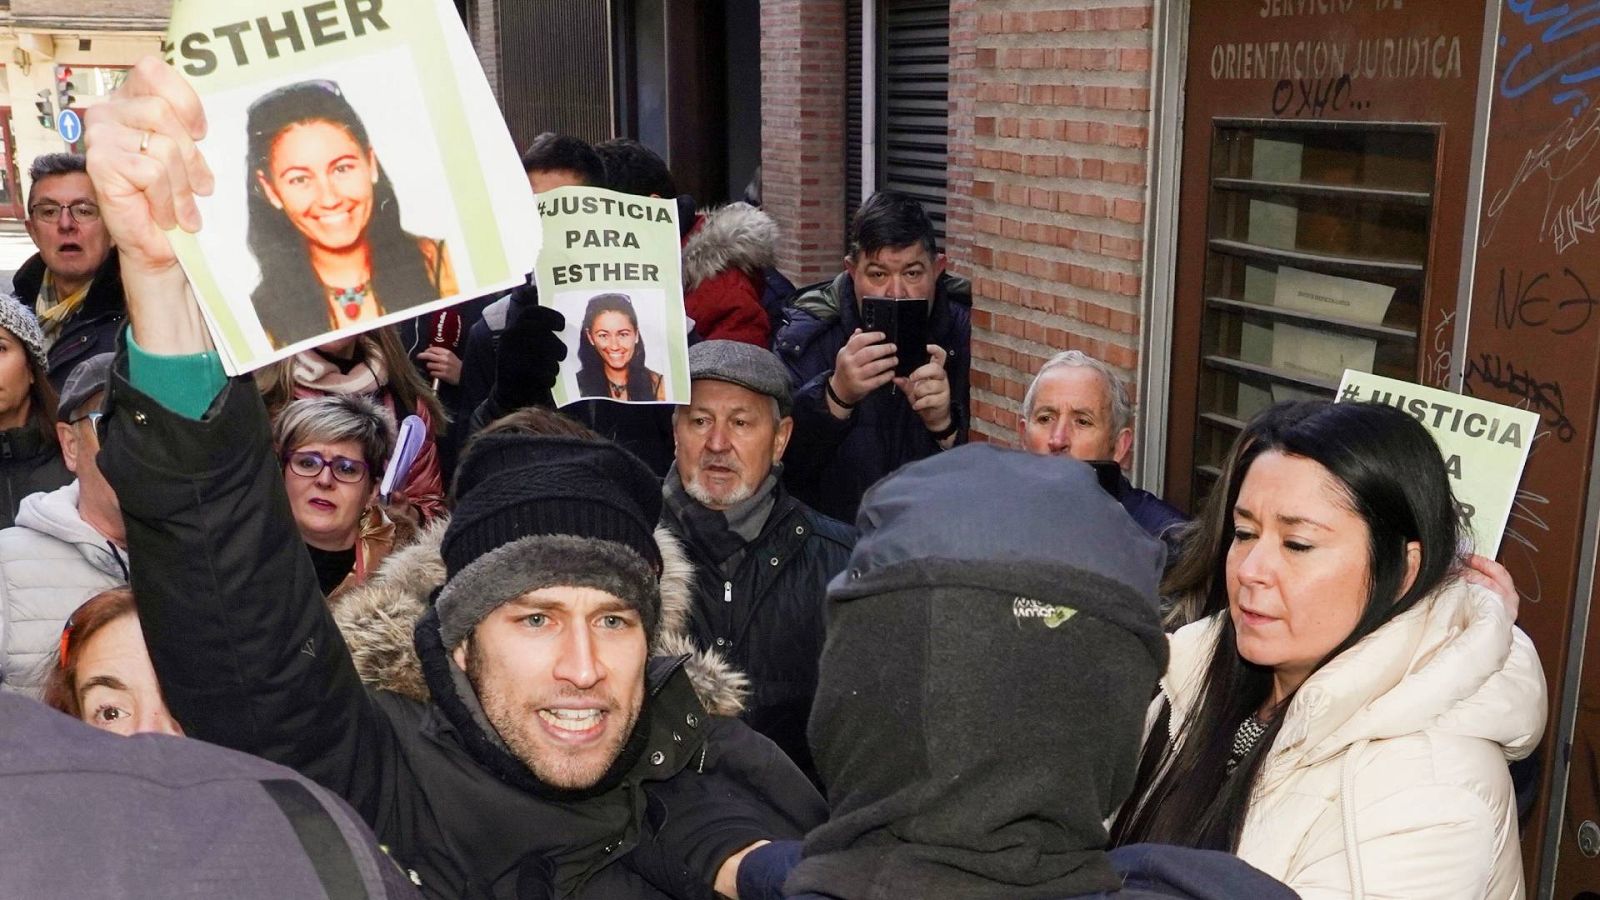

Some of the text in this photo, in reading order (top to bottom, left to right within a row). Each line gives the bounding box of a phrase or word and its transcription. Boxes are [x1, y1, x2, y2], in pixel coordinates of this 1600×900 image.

[165, 0, 391, 77] STHER
[537, 196, 673, 224] #JUSTICIA
[565, 229, 641, 249] PARA
[552, 262, 660, 286] ESTHER
